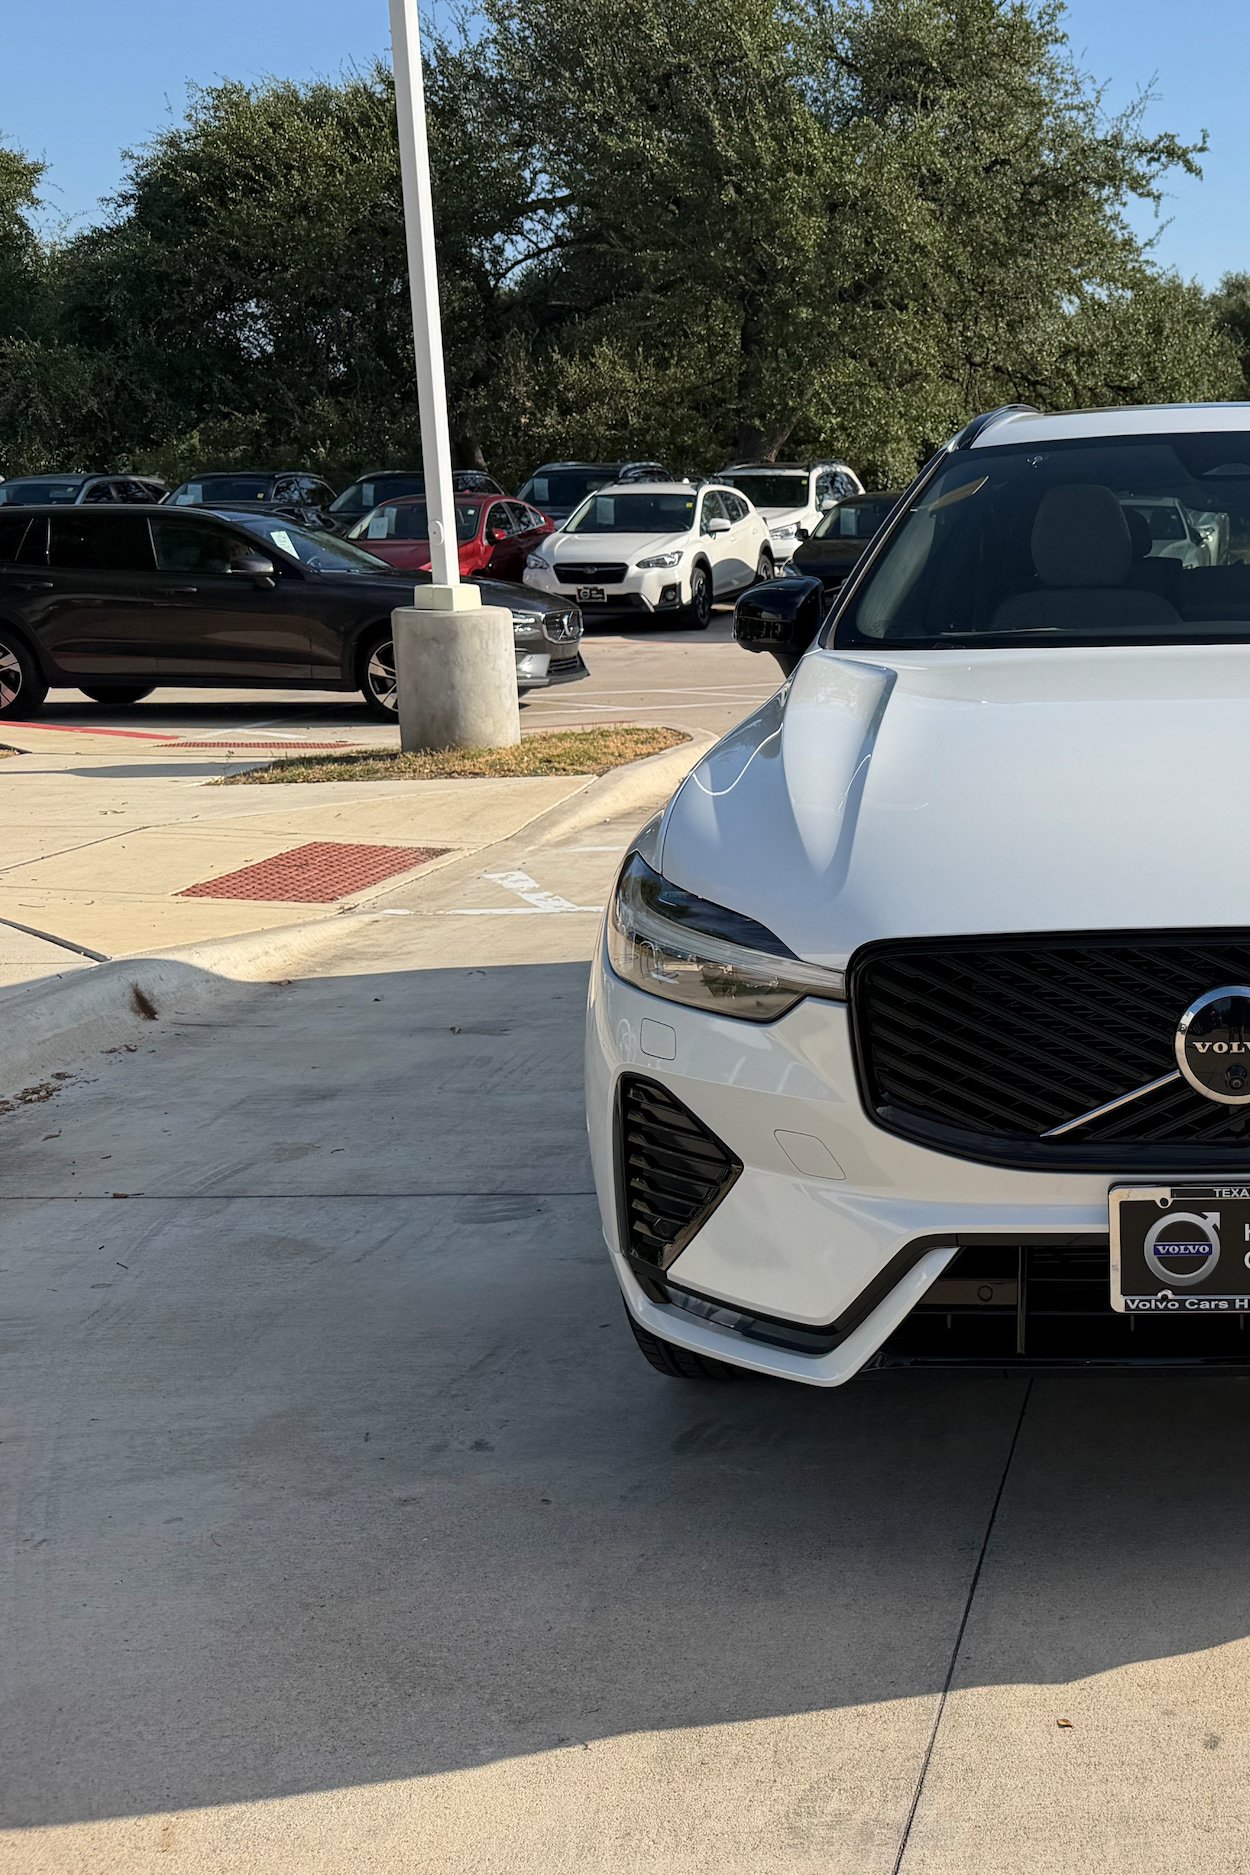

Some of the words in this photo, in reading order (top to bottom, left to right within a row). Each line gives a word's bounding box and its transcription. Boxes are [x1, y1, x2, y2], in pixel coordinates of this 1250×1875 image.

[1156, 1244, 1210, 1255] VOLVO
[1126, 1298, 1179, 1310] Volvo
[1184, 1299, 1229, 1310] Cars
